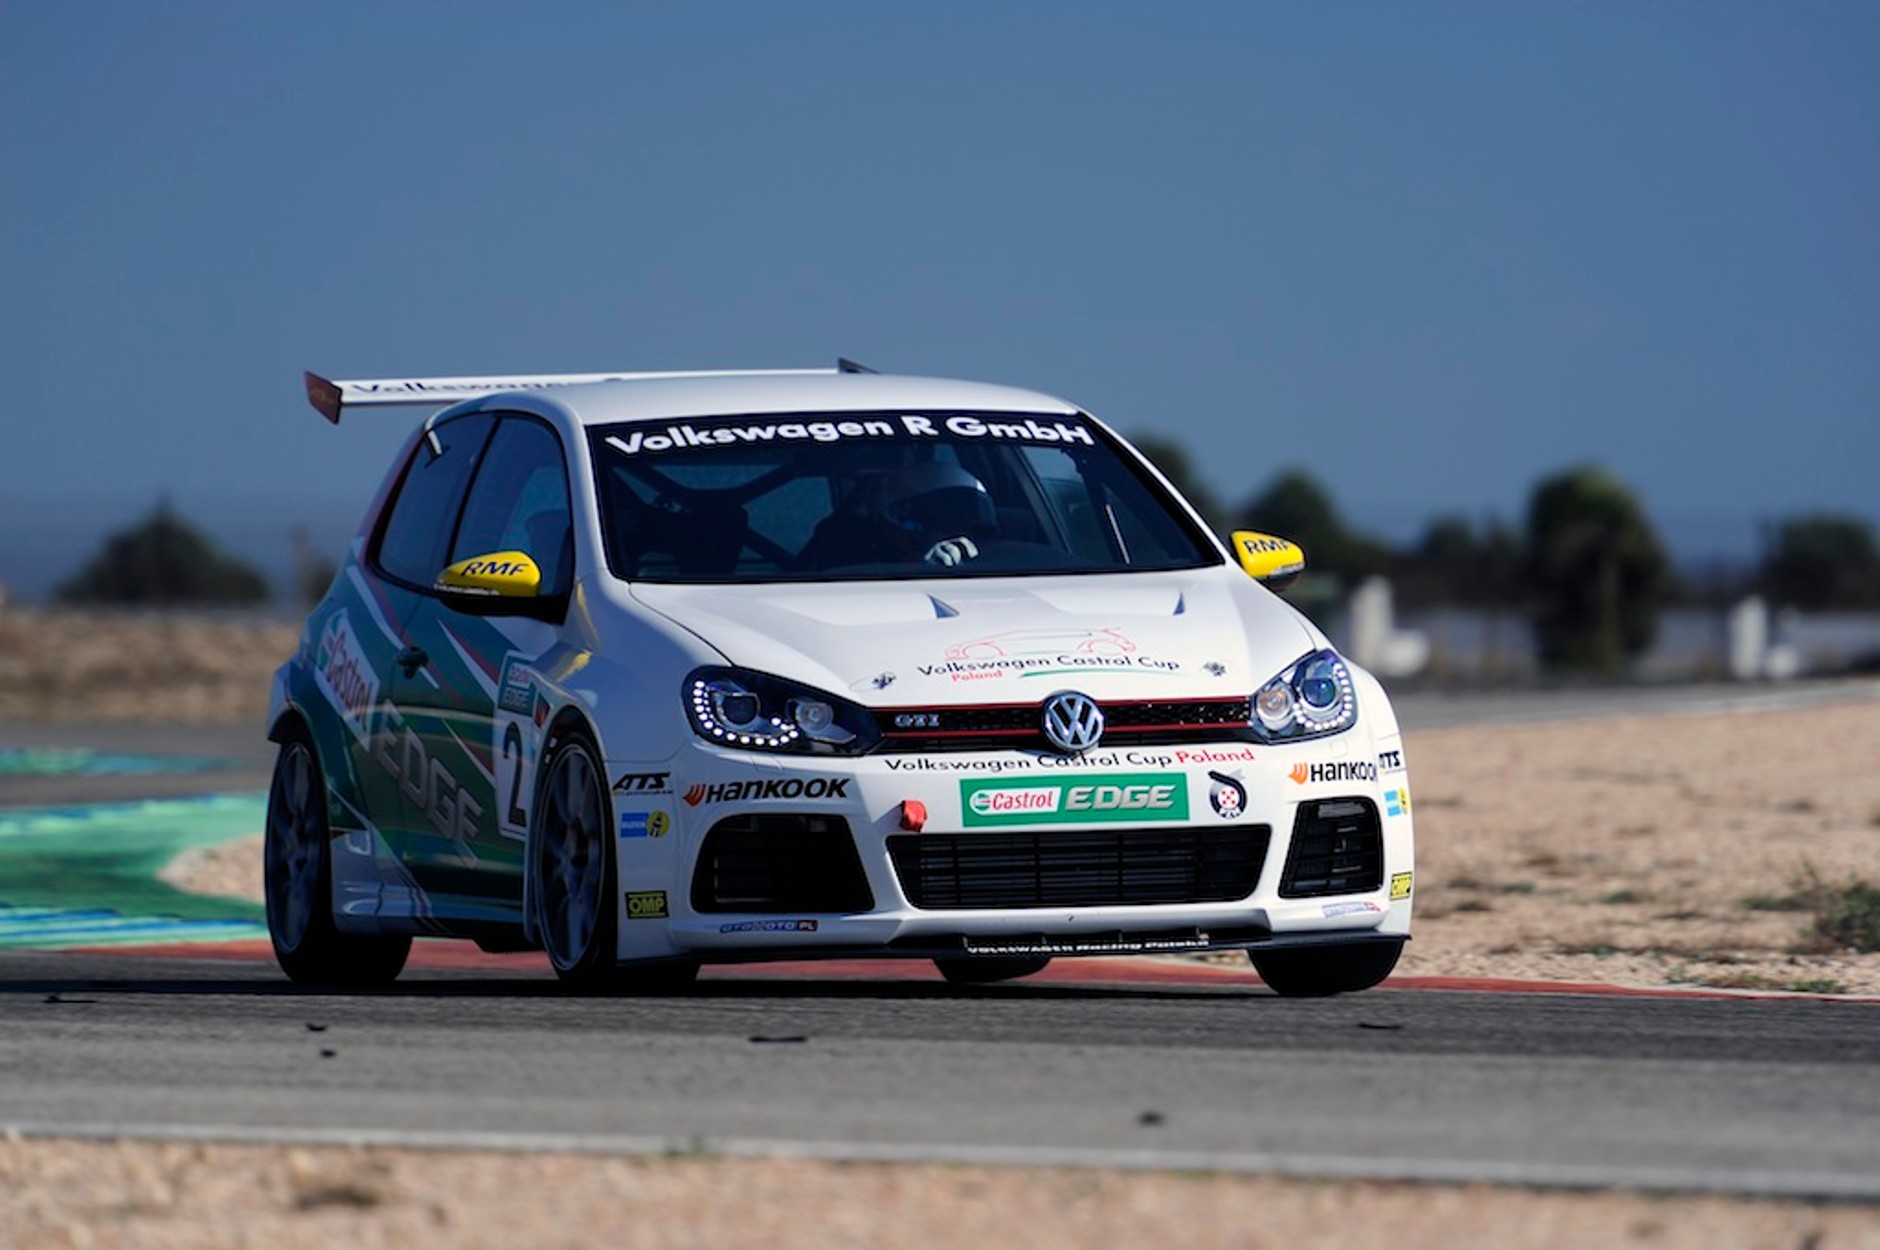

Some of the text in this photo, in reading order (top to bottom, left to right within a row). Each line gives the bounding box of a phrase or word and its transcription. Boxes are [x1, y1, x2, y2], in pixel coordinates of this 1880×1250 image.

[604, 415, 1096, 454] Volkswagen R GmbH
[461, 561, 529, 577] RMF
[917, 654, 1181, 677] Volkswagen Castrol Cup
[951, 670, 1004, 683] Poland
[894, 713, 941, 728] GTI
[885, 748, 1256, 773] Volkswagen Castrol Cup Poland
[375, 698, 484, 868] EDGE
[503, 721, 528, 828] 2
[612, 772, 671, 790] ATS
[992, 785, 1177, 811] Castrol EDGE
[628, 898, 665, 913] OMP
